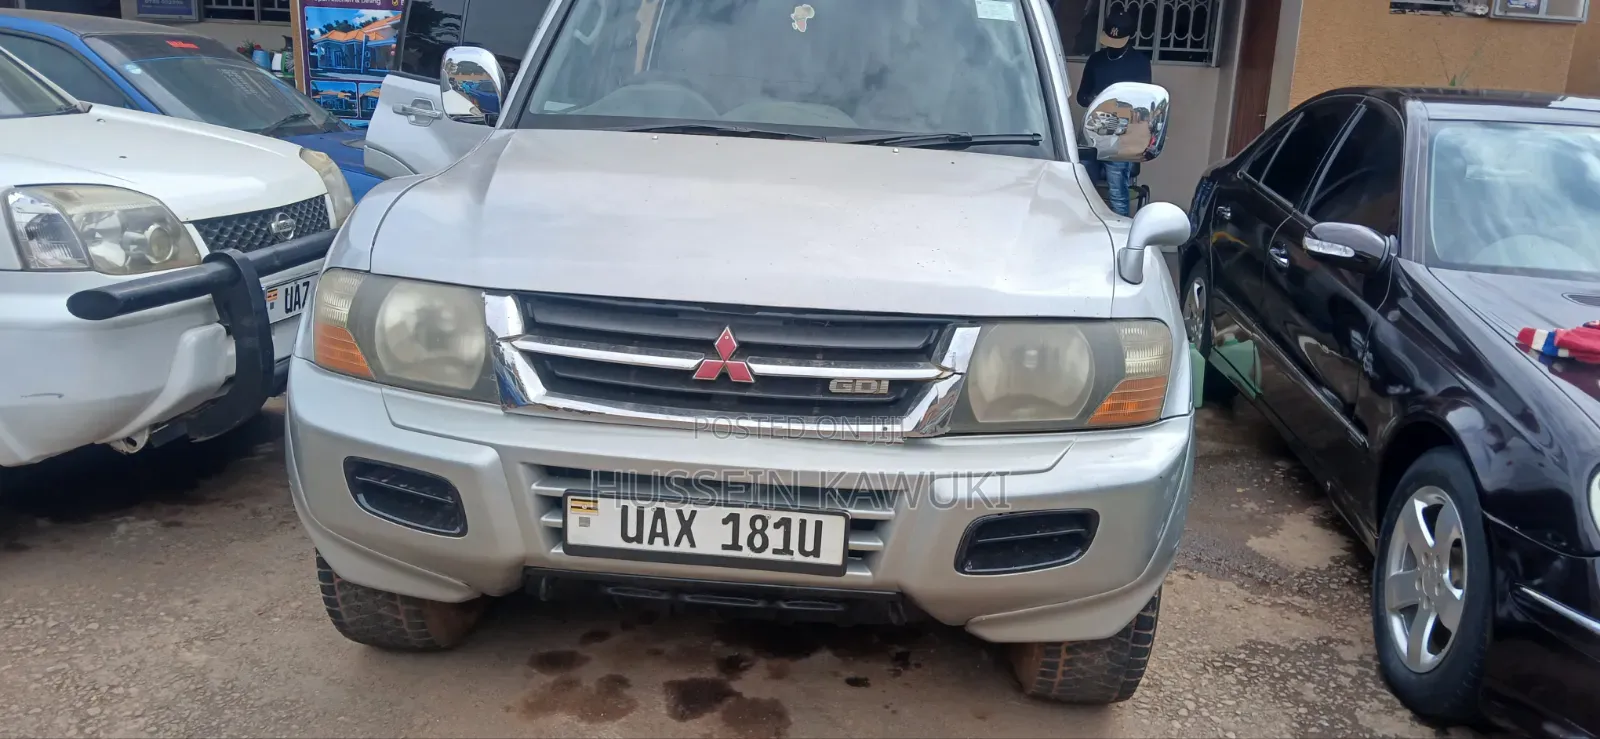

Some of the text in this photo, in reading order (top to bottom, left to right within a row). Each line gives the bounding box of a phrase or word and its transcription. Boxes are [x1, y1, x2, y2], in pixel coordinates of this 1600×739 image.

[829, 379, 889, 394] GDI
[620, 504, 823, 559] UAX 181U
